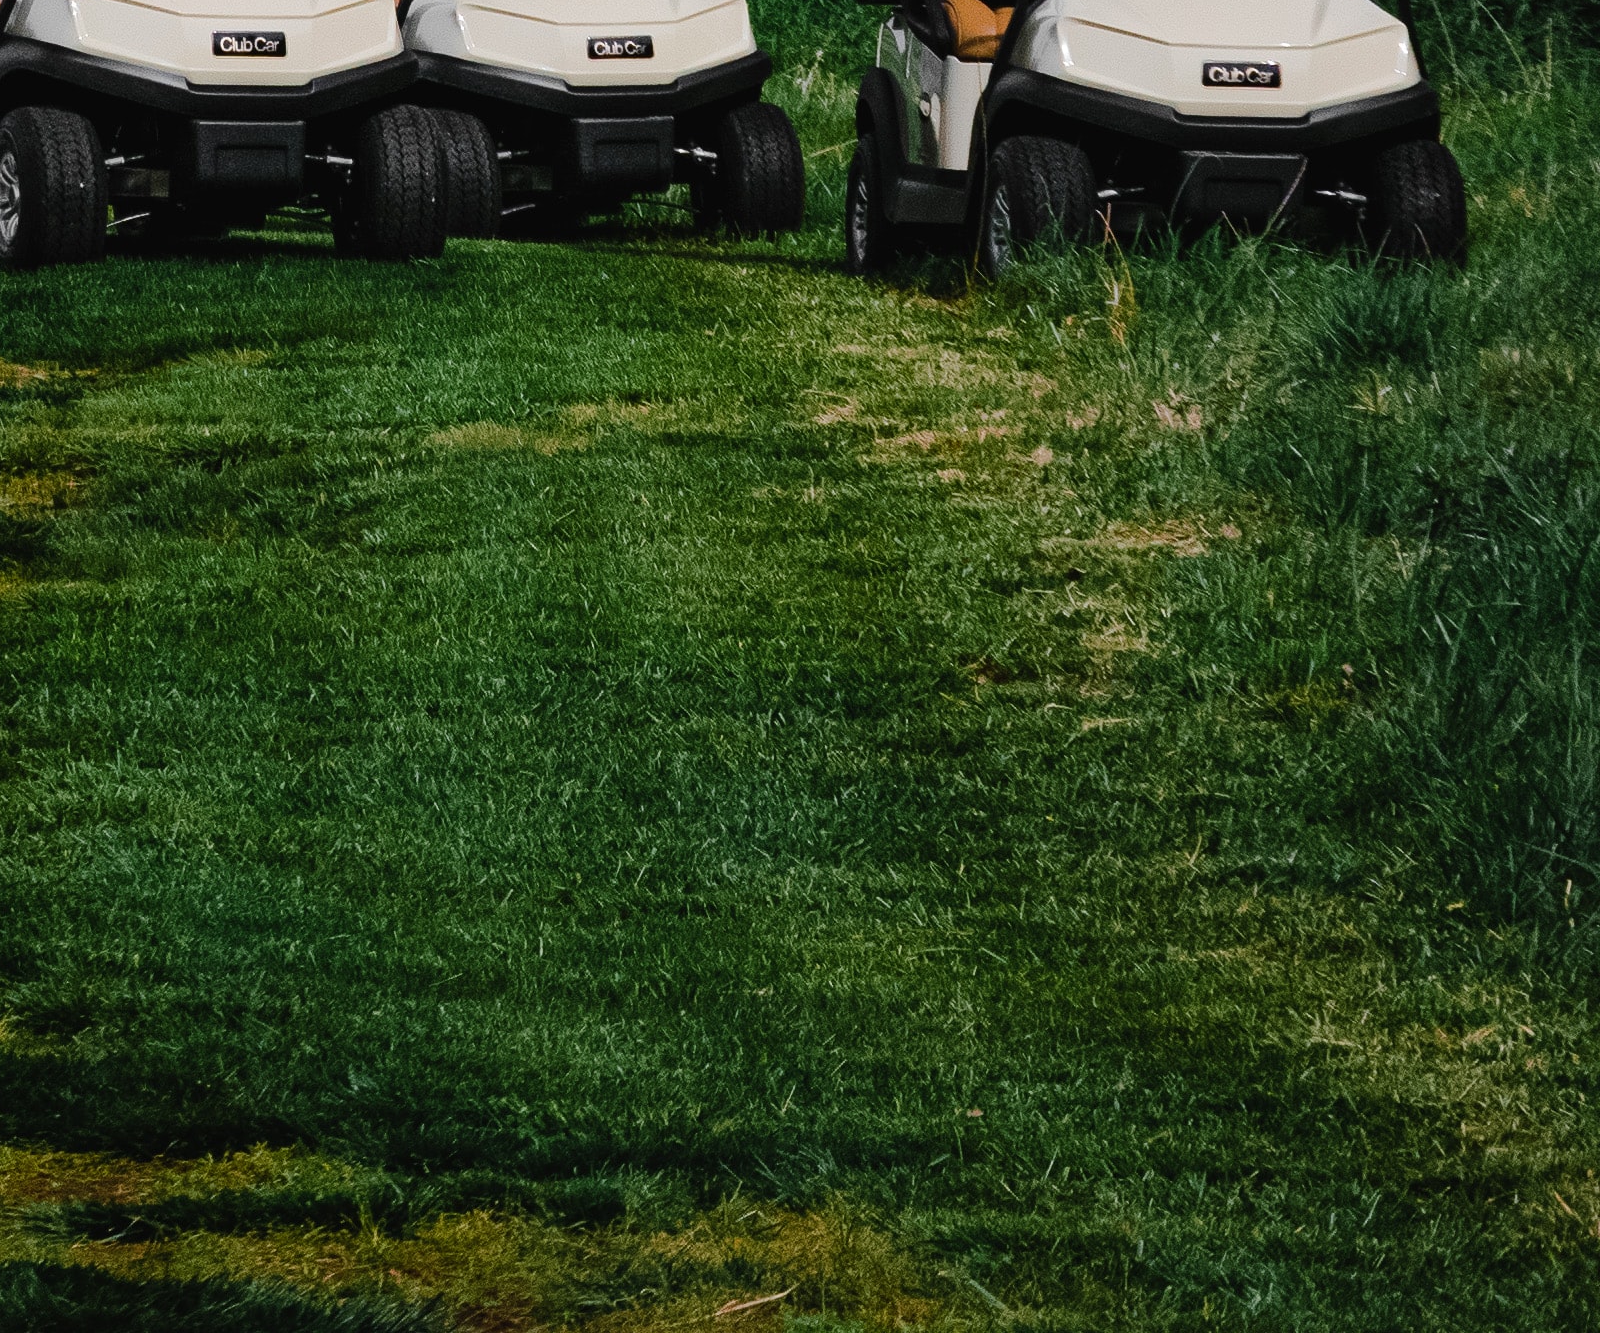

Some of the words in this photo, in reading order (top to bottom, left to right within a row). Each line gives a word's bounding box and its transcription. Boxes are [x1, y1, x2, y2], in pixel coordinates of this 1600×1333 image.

[220, 36, 253, 52] Club
[254, 36, 280, 52] Car
[594, 41, 624, 56] Club
[1208, 66, 1245, 83] Club
[1246, 66, 1274, 83] Car
